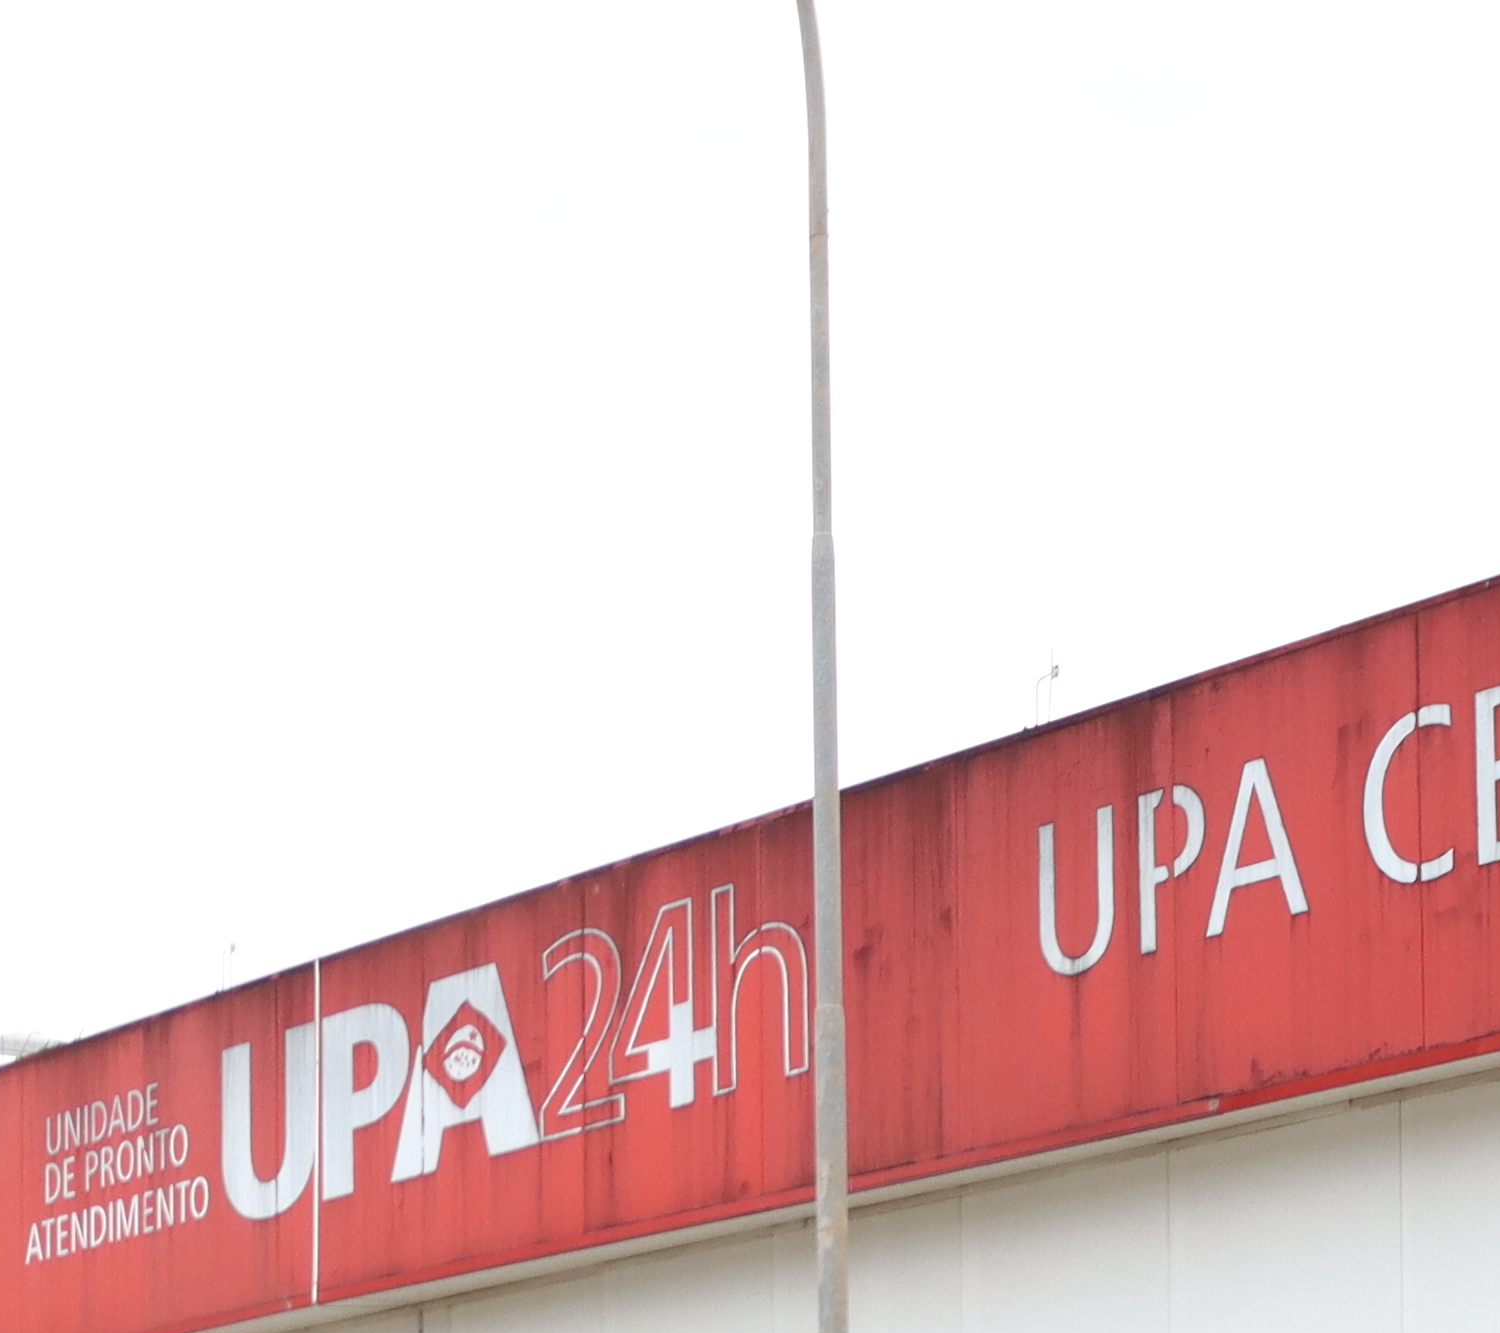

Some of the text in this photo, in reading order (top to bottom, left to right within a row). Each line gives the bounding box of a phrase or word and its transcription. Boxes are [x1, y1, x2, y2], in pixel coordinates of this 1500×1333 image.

[1038, 757, 1309, 976] UPA
[45, 1082, 159, 1155] UNIDADE
[44, 1123, 189, 1205] DE PRONTO
[24, 1175, 210, 1265] ATENDIMENTO
